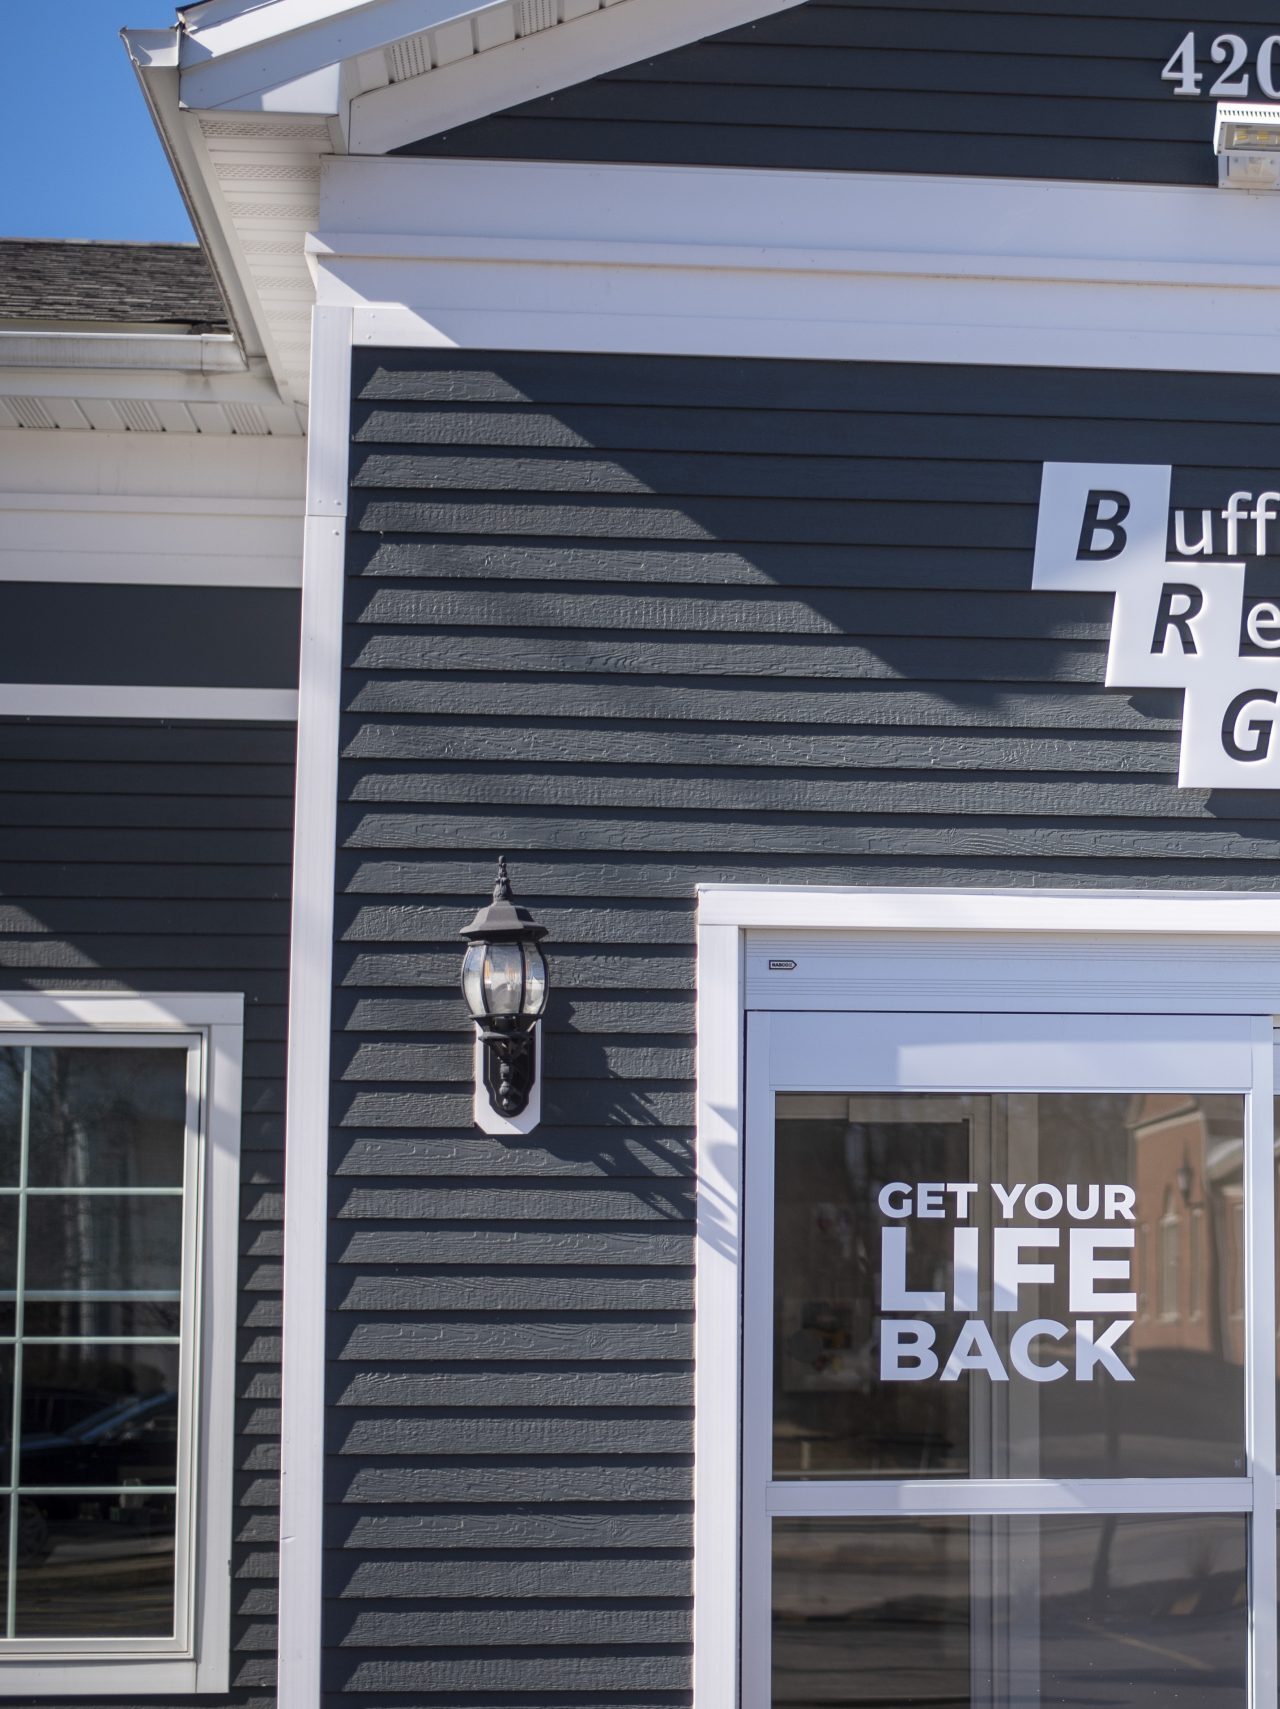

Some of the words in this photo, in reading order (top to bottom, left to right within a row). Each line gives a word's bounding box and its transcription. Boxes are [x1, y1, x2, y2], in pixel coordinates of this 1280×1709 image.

[878, 1182, 978, 1219] GET
[990, 1183, 1136, 1220] YOUR
[881, 1226, 1137, 1311] LIFE
[880, 1319, 1136, 1382] BACK
